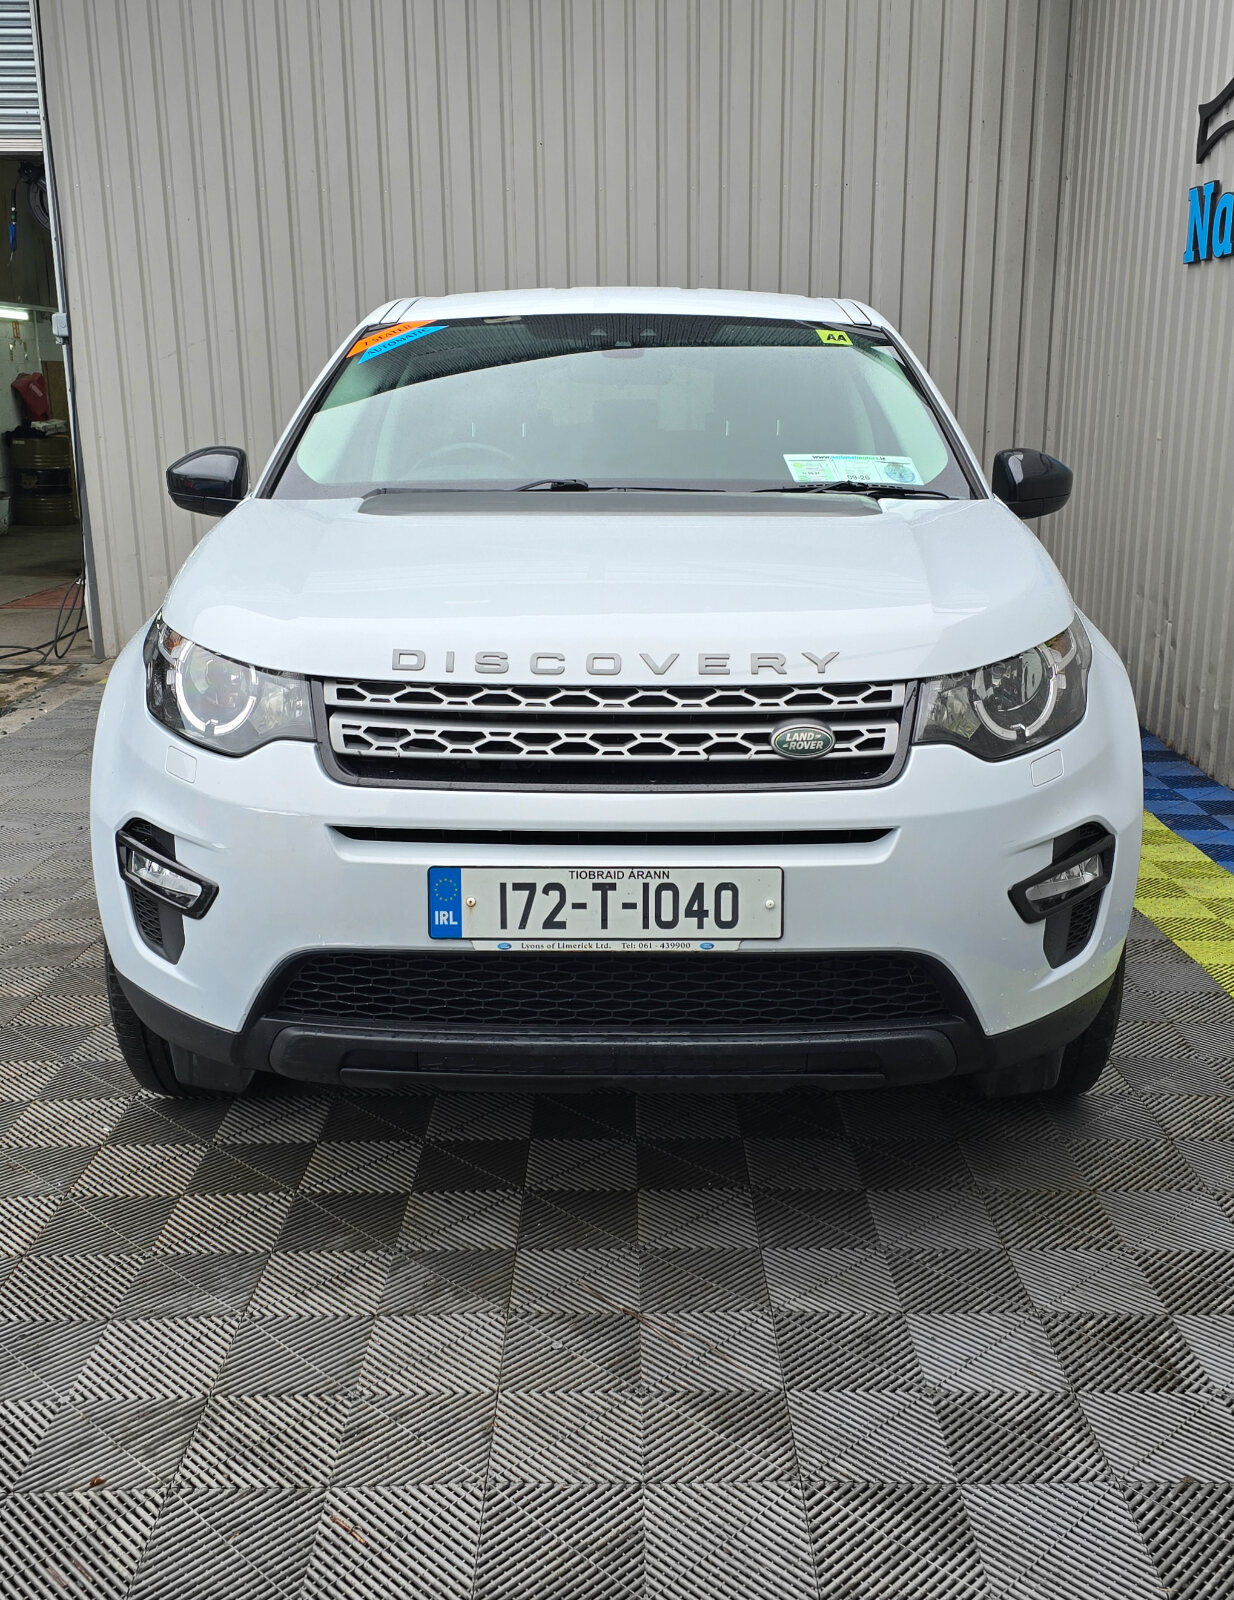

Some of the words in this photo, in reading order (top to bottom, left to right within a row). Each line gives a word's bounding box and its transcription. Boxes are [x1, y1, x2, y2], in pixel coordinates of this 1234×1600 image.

[372, 324, 413, 343] SEATER
[826, 333, 847, 342] AA
[367, 327, 432, 356] AUTOMATIC
[392, 648, 840, 676] DISCOVERY
[785, 732, 815, 742] LAND
[788, 740, 824, 750] ROVER
[569, 870, 625, 880] TIOBRAID
[629, 867, 670, 880] ÁRANN
[499, 881, 740, 931] 172-T-1040
[434, 910, 459, 926] IRL
[521, 942, 545, 950] Lyons
